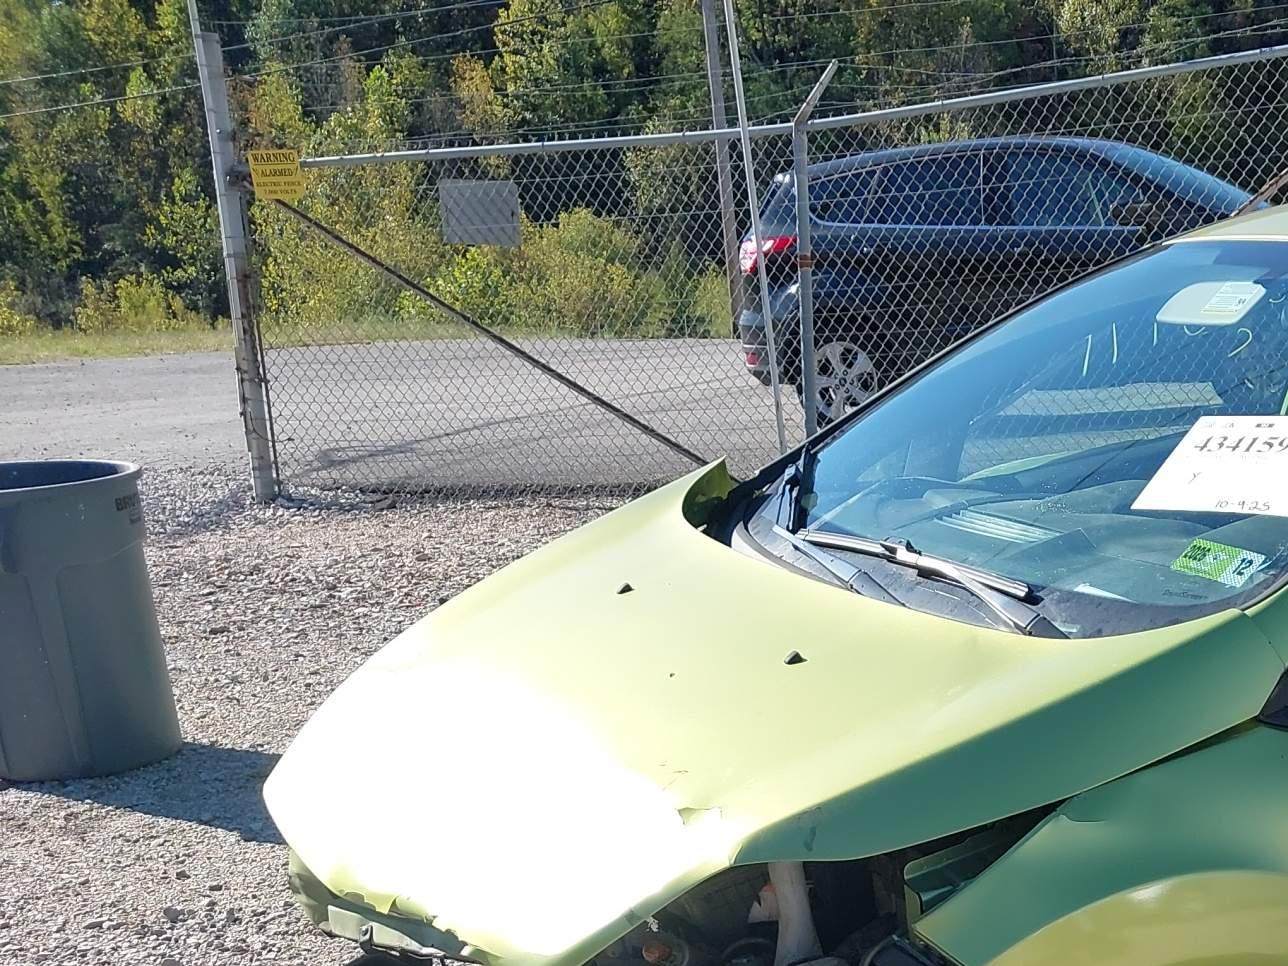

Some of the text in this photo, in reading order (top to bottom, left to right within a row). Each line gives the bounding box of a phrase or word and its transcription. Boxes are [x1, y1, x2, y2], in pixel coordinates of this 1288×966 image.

[251, 151, 295, 163] WARNING
[260, 168, 294, 178] ALARMED
[1232, 557, 1254, 577] 12
